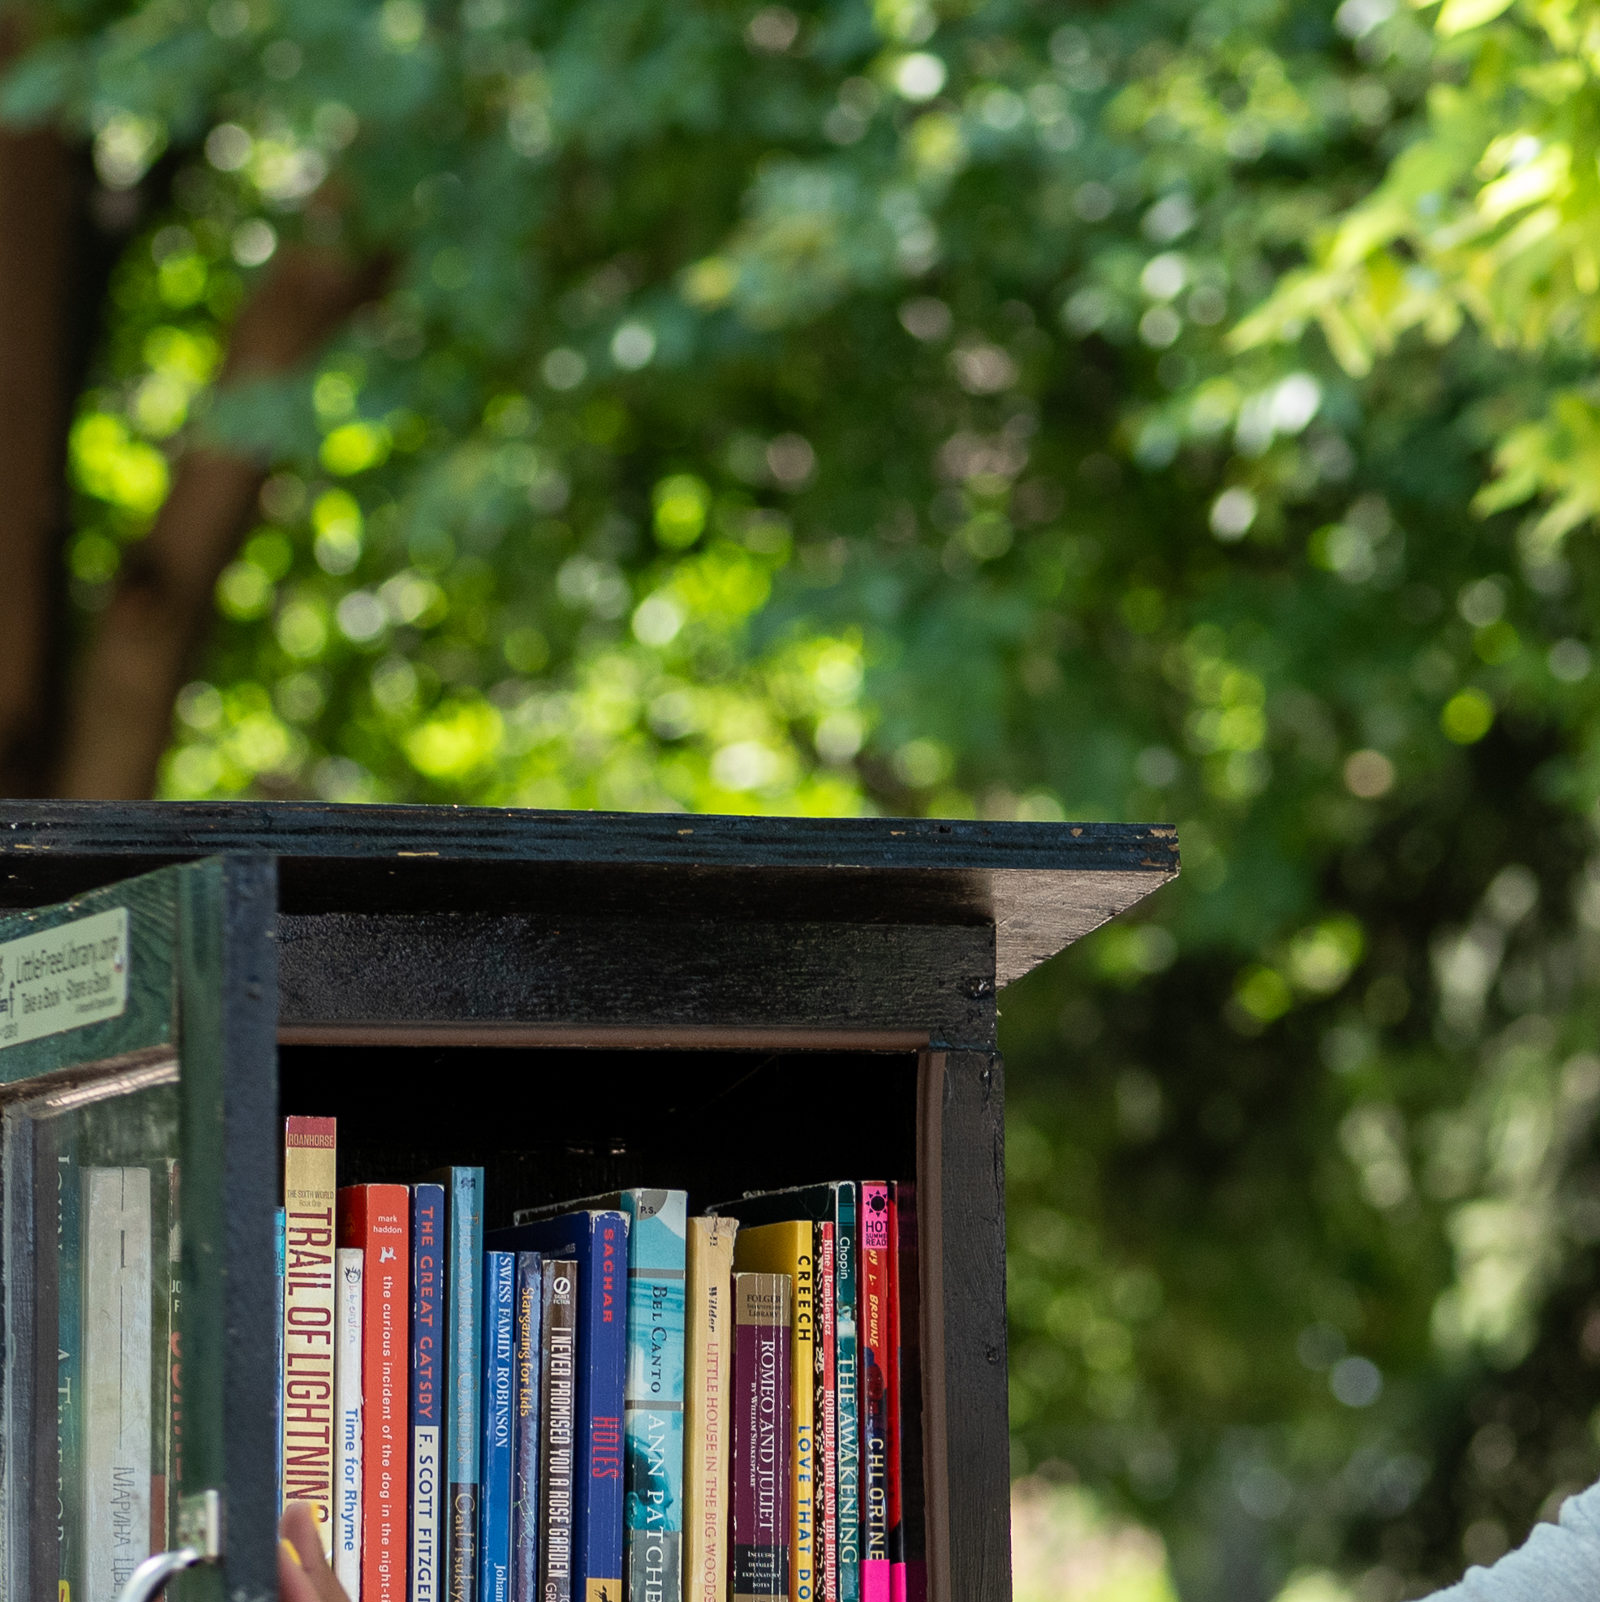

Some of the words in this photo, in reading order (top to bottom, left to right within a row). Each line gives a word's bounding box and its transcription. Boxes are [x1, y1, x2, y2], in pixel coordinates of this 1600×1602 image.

[288, 1133, 334, 1147] ROANHORSE
[373, 1225, 402, 1234] haddon
[378, 1214, 398, 1223] mark
[421, 1206, 434, 1247] THE
[288, 1207, 333, 1296] TRAIL
[839, 1237, 850, 1280] Chopin
[382, 1276, 394, 1298] the
[420, 1255, 433, 1327] GREAT
[499, 1256, 512, 1302] SWISS
[603, 1228, 614, 1323] SACHAR
[747, 1294, 781, 1302] FOLGER
[798, 1255, 811, 1341] CREECH
[287, 1306, 331, 1345] OF
[652, 1285, 667, 1322] BEL
[708, 1286, 718, 1333] Wilder
[382, 1303, 394, 1357] curious
[497, 1306, 511, 1359] FAMILY
[419, 1336, 432, 1419] GATSBY
[551, 1336, 572, 1377] NEVER
[651, 1326, 667, 1394] CANTO
[706, 1343, 719, 1392] LITTLE
[760, 1341, 775, 1413] ROMEO
[837, 1355, 855, 1403] THE
[381, 1362, 393, 1421] incident
[495, 1367, 510, 1448] ROBINSON
[550, 1380, 571, 1444] PROMISED
[286, 1353, 331, 1523] LIGHTNIN
[345, 1408, 358, 1452] Time
[381, 1425, 393, 1438] of
[420, 1434, 433, 1449] F.
[705, 1396, 718, 1446] HOUSE
[760, 1418, 774, 1463] AND
[824, 1390, 835, 1449] HORRIBLE
[381, 1442, 392, 1467] the
[549, 1448, 570, 1474] YOU
[592, 1416, 619, 1479] HOLES
[648, 1414, 665, 1477] ANN
[706, 1453, 717, 1473] IN
[798, 1426, 811, 1482] LOVE
[345, 1458, 359, 1484] for
[379, 1472, 392, 1499] dog
[418, 1454, 433, 1518] SCOTT
[549, 1479, 569, 1492] A
[705, 1475, 717, 1507] THE
[825, 1454, 835, 1490] HARRY
[838, 1407, 858, 1563] AWAKENING
[341, 1490, 357, 1551] Rhyme
[381, 1504, 391, 1517] in
[548, 1496, 569, 1524] ROSE
[757, 1465, 774, 1533] JULIET
[825, 1491, 835, 1515] AND
[868, 1438, 885, 1560] CHLORINE
[381, 1521, 392, 1546] the
[705, 1511, 717, 1537] BIG
[797, 1497, 811, 1554] THAT
[826, 1518, 835, 1539] THE
[547, 1529, 569, 1578] GARDEN
[826, 1543, 836, 1600] HOLIDAZE
